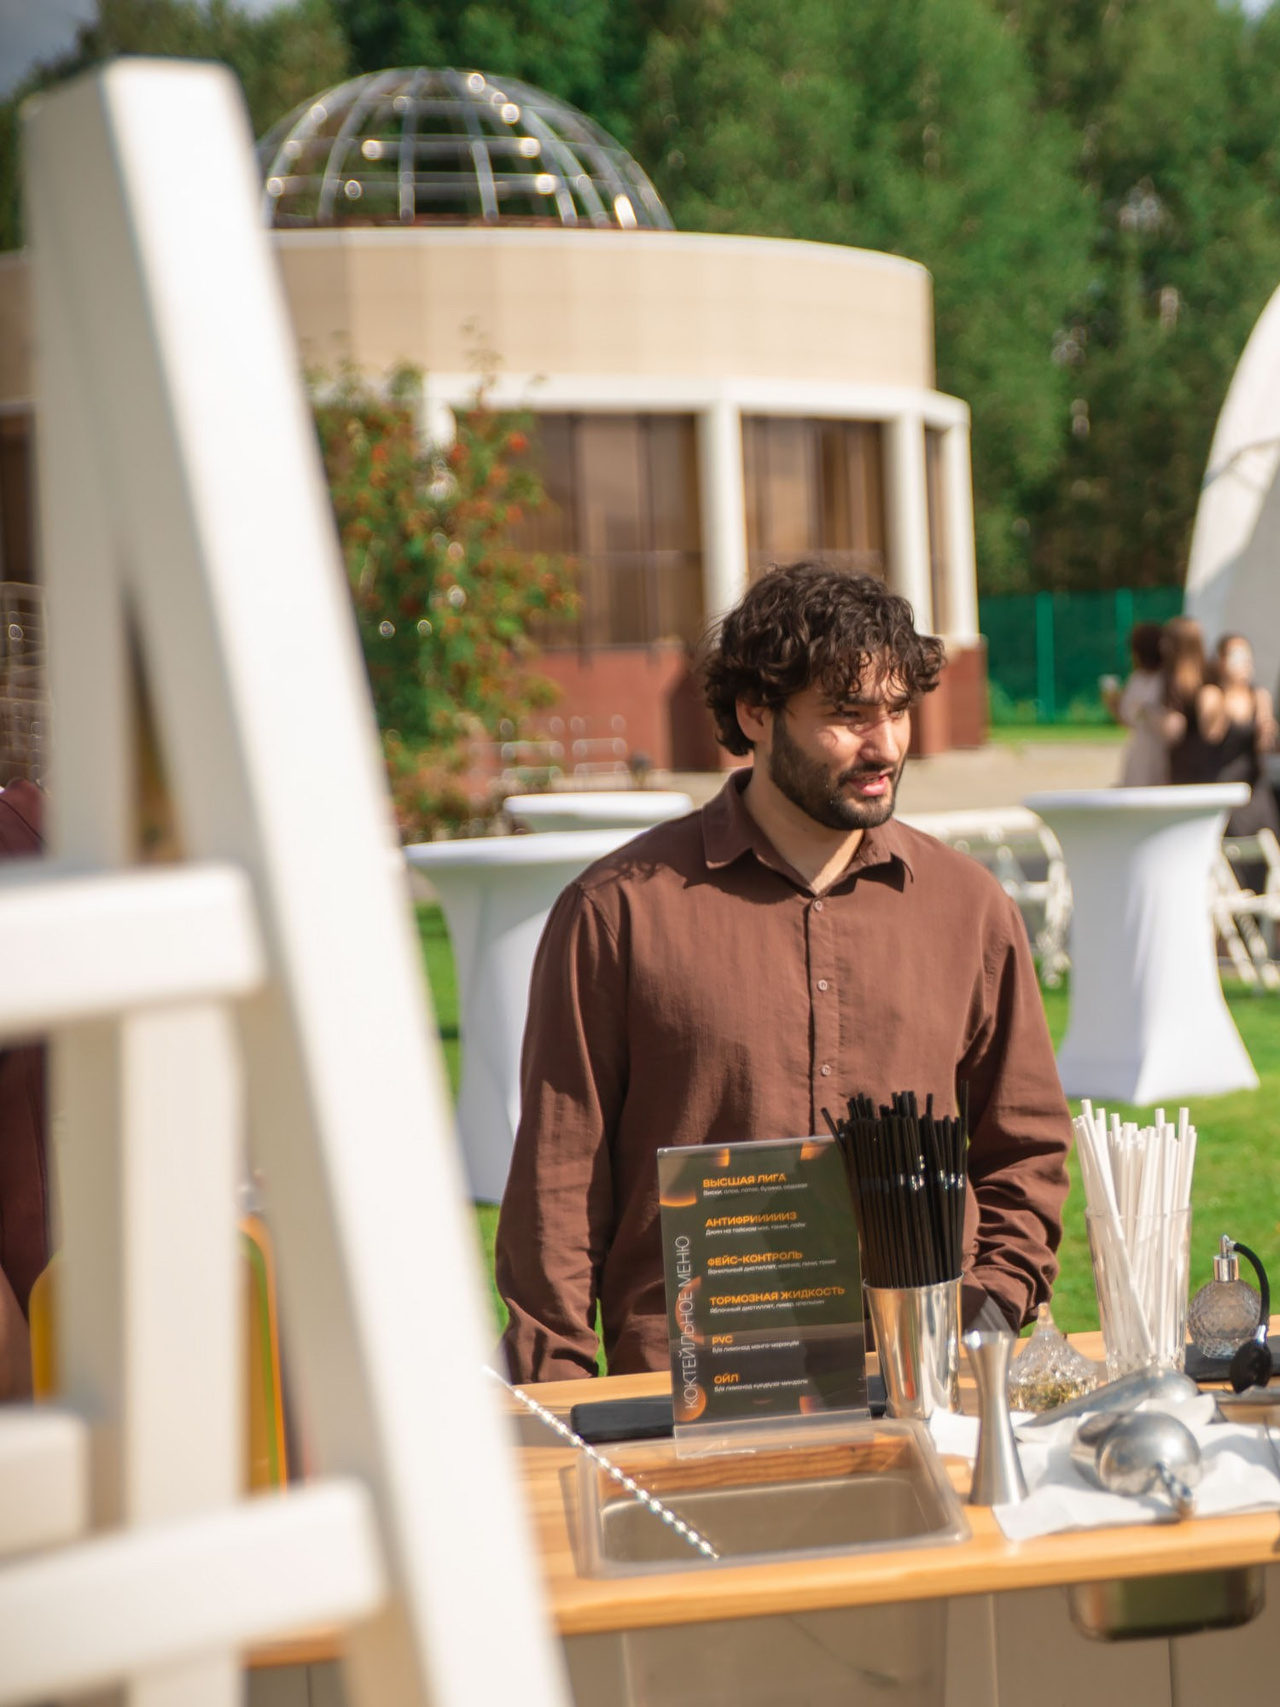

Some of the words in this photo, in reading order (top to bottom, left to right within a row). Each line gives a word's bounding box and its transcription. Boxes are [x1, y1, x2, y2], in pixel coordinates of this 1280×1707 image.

[702, 1176, 756, 1188] ВЫСШАЯ
[756, 1172, 787, 1184] ЛИГА
[674, 1235, 691, 1288] МЕНЮ
[707, 1250, 803, 1267] ФЕЙС-КОНТРОЛЬ
[709, 1291, 779, 1306] ТОРМОЗНАЯ
[780, 1286, 846, 1300] ЖИДКОСТЬ
[678, 1291, 699, 1409] КОКТЕЙЛЬНОЕ
[714, 1372, 740, 1384] ОЙЛ
